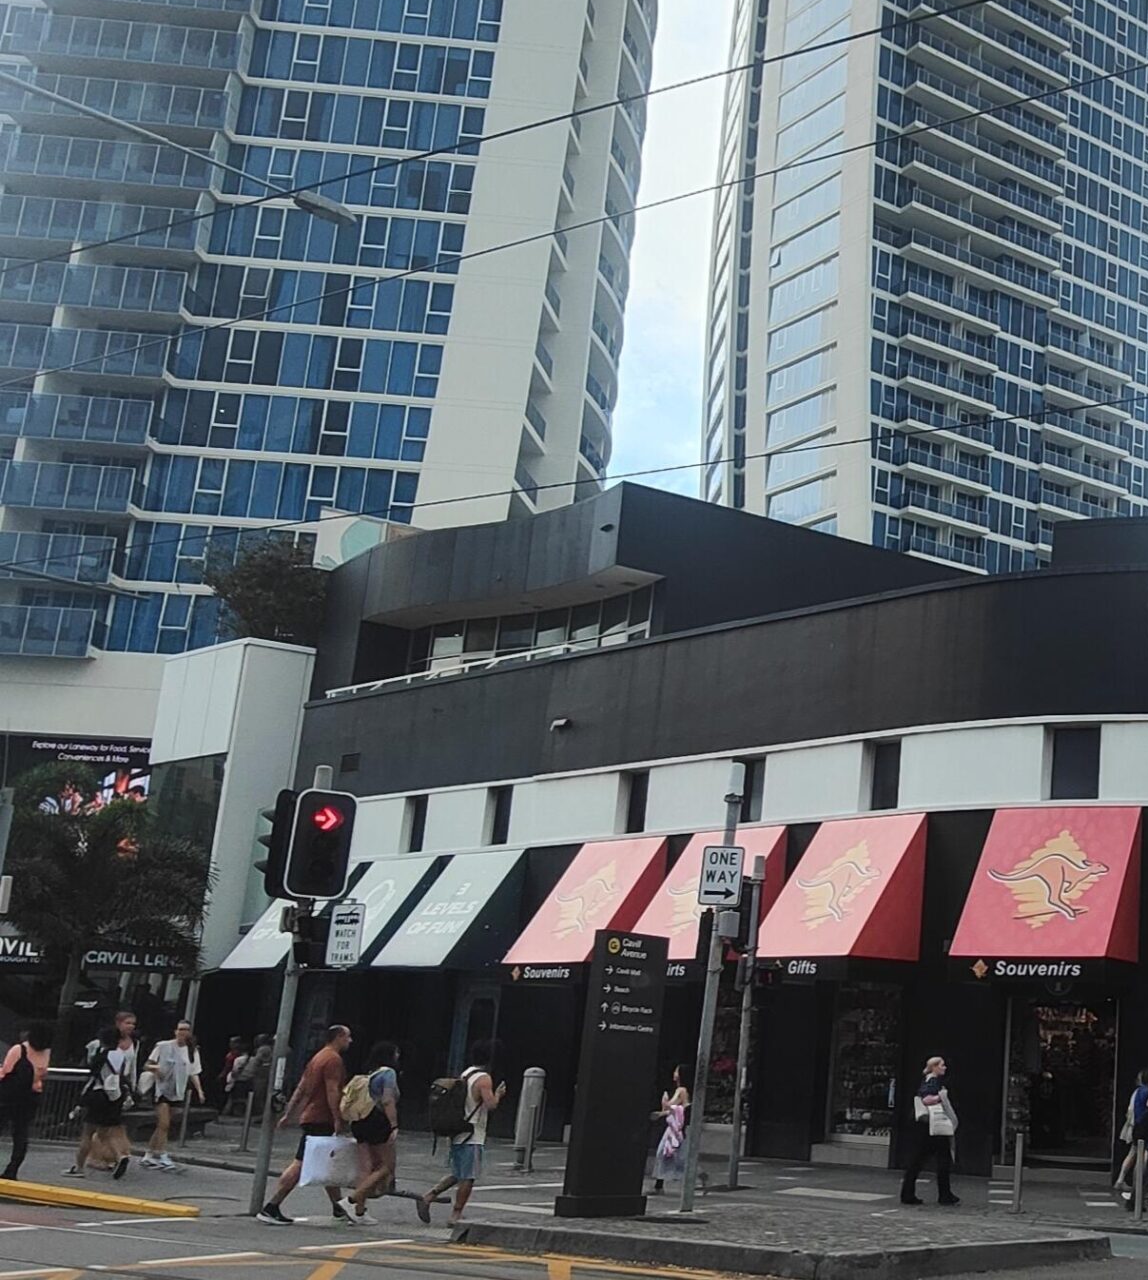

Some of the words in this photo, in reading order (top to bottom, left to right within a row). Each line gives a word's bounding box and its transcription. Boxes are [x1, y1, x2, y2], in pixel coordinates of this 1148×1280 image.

[709, 851, 738, 866] ONE
[705, 869, 738, 884] WAY
[421, 900, 480, 916] LEVELS
[335, 929, 356, 938] WATCH
[336, 940, 350, 950] FOR
[622, 938, 642, 948] Cavill
[86, 950, 141, 966] CAVILL
[621, 949, 647, 959] Avenue
[523, 966, 570, 978] Souvenirs
[666, 963, 685, 976] irts
[787, 959, 818, 974] Gifts
[994, 960, 1082, 976] Souvenirs
